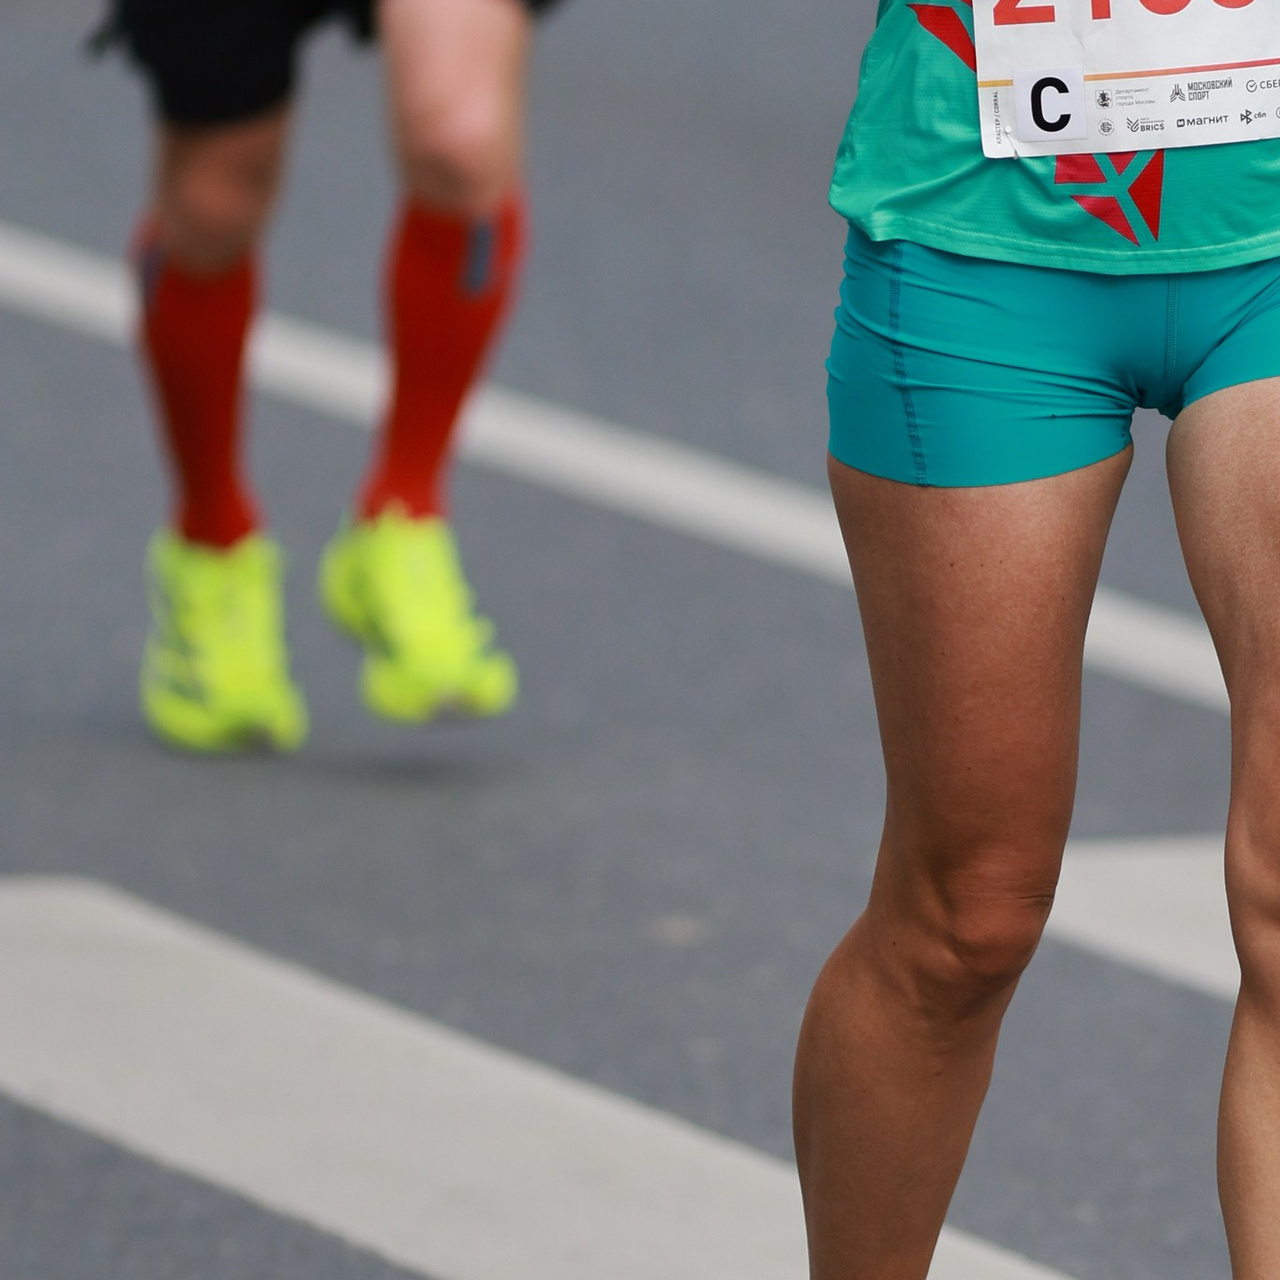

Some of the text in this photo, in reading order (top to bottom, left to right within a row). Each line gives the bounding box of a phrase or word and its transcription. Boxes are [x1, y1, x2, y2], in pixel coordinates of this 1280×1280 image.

[1187, 77, 1233, 92] МОСКОВСКИЙ
[1188, 90, 1210, 101] СПОРТ
[1030, 76, 1071, 133] C
[1140, 123, 1165, 132] BRICS
